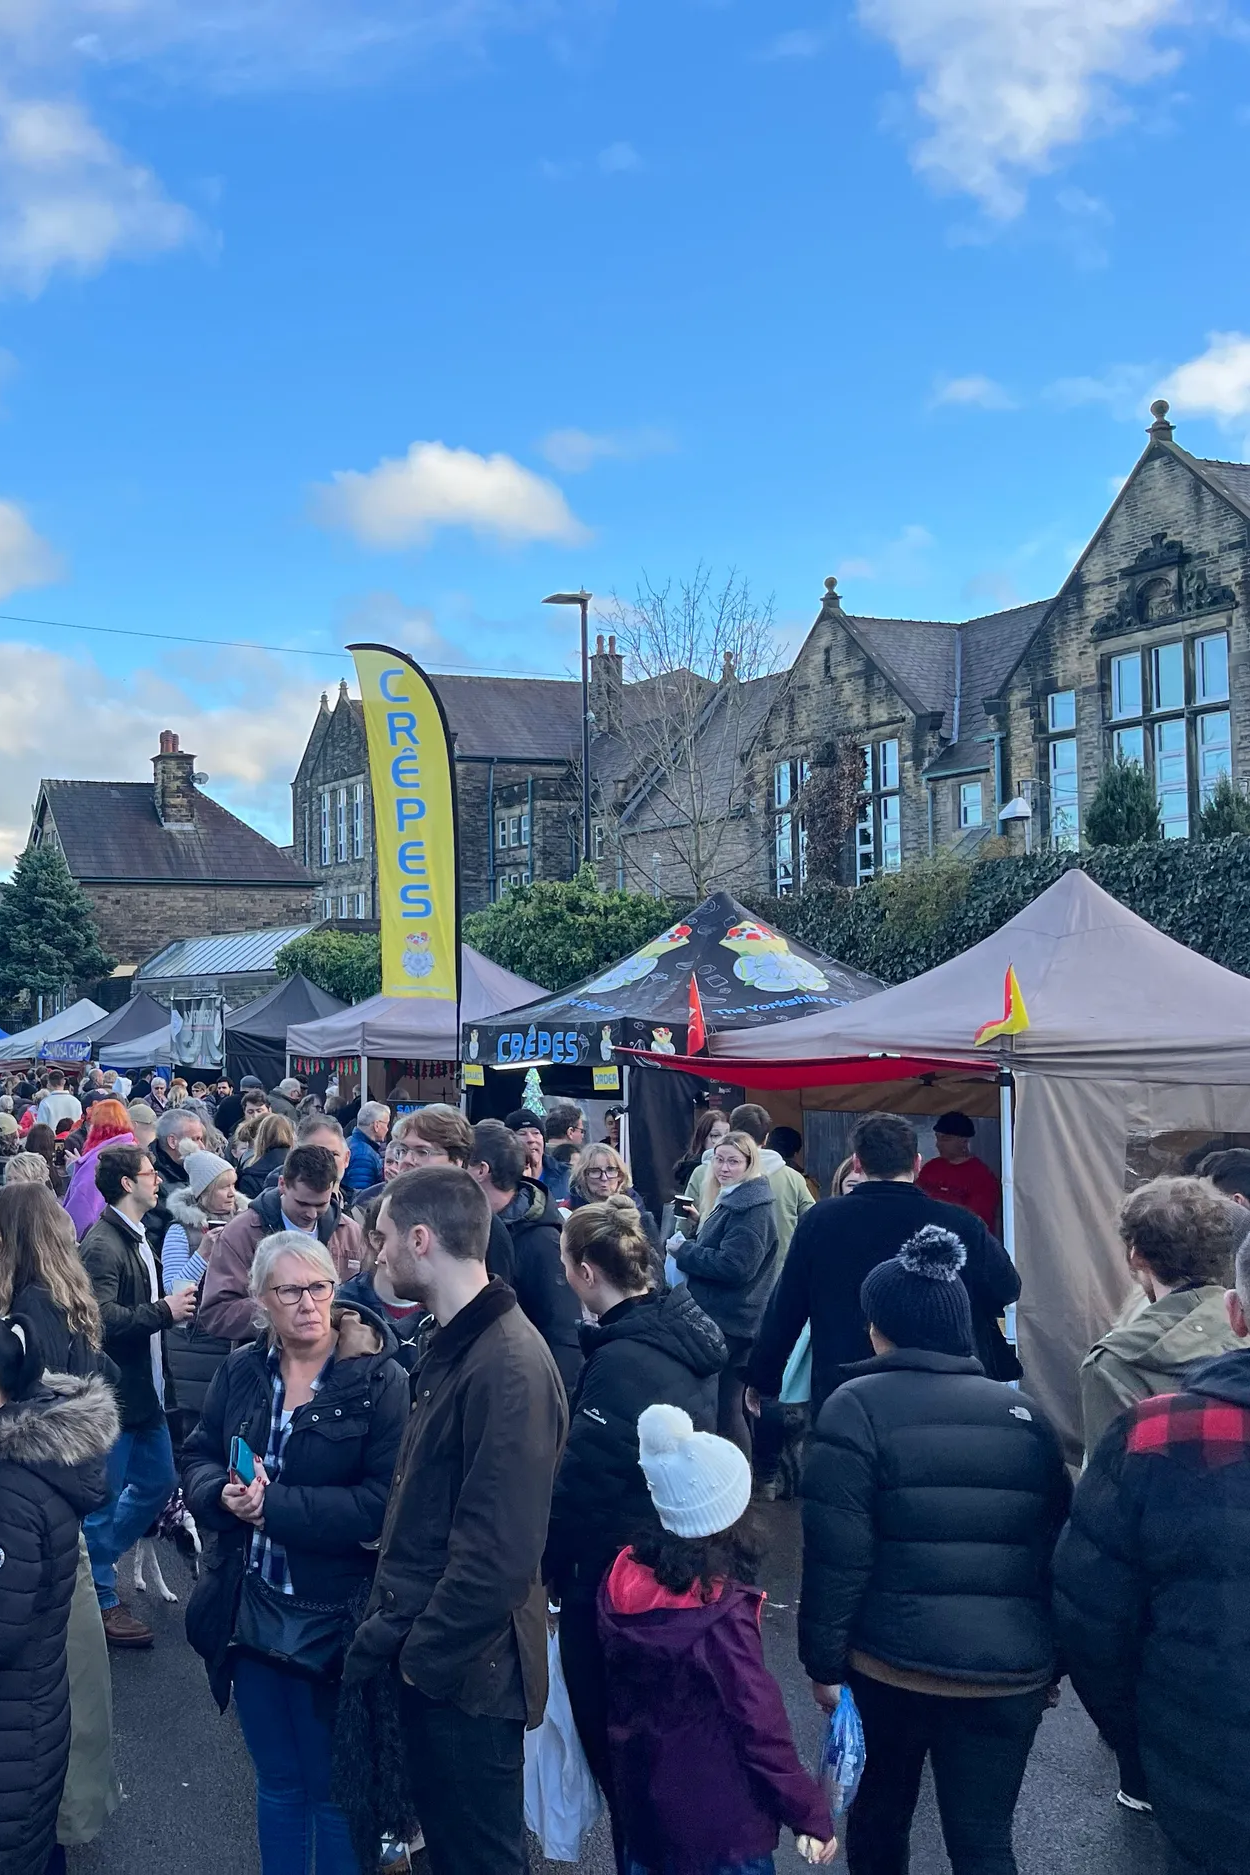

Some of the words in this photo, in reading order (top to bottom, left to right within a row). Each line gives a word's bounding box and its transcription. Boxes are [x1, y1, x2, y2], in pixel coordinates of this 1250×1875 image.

[713, 1008, 747, 1016] The
[746, 994, 830, 1012] Yorkshire
[497, 1024, 580, 1064] CRÊPES
[594, 1074, 619, 1084] ORDER
